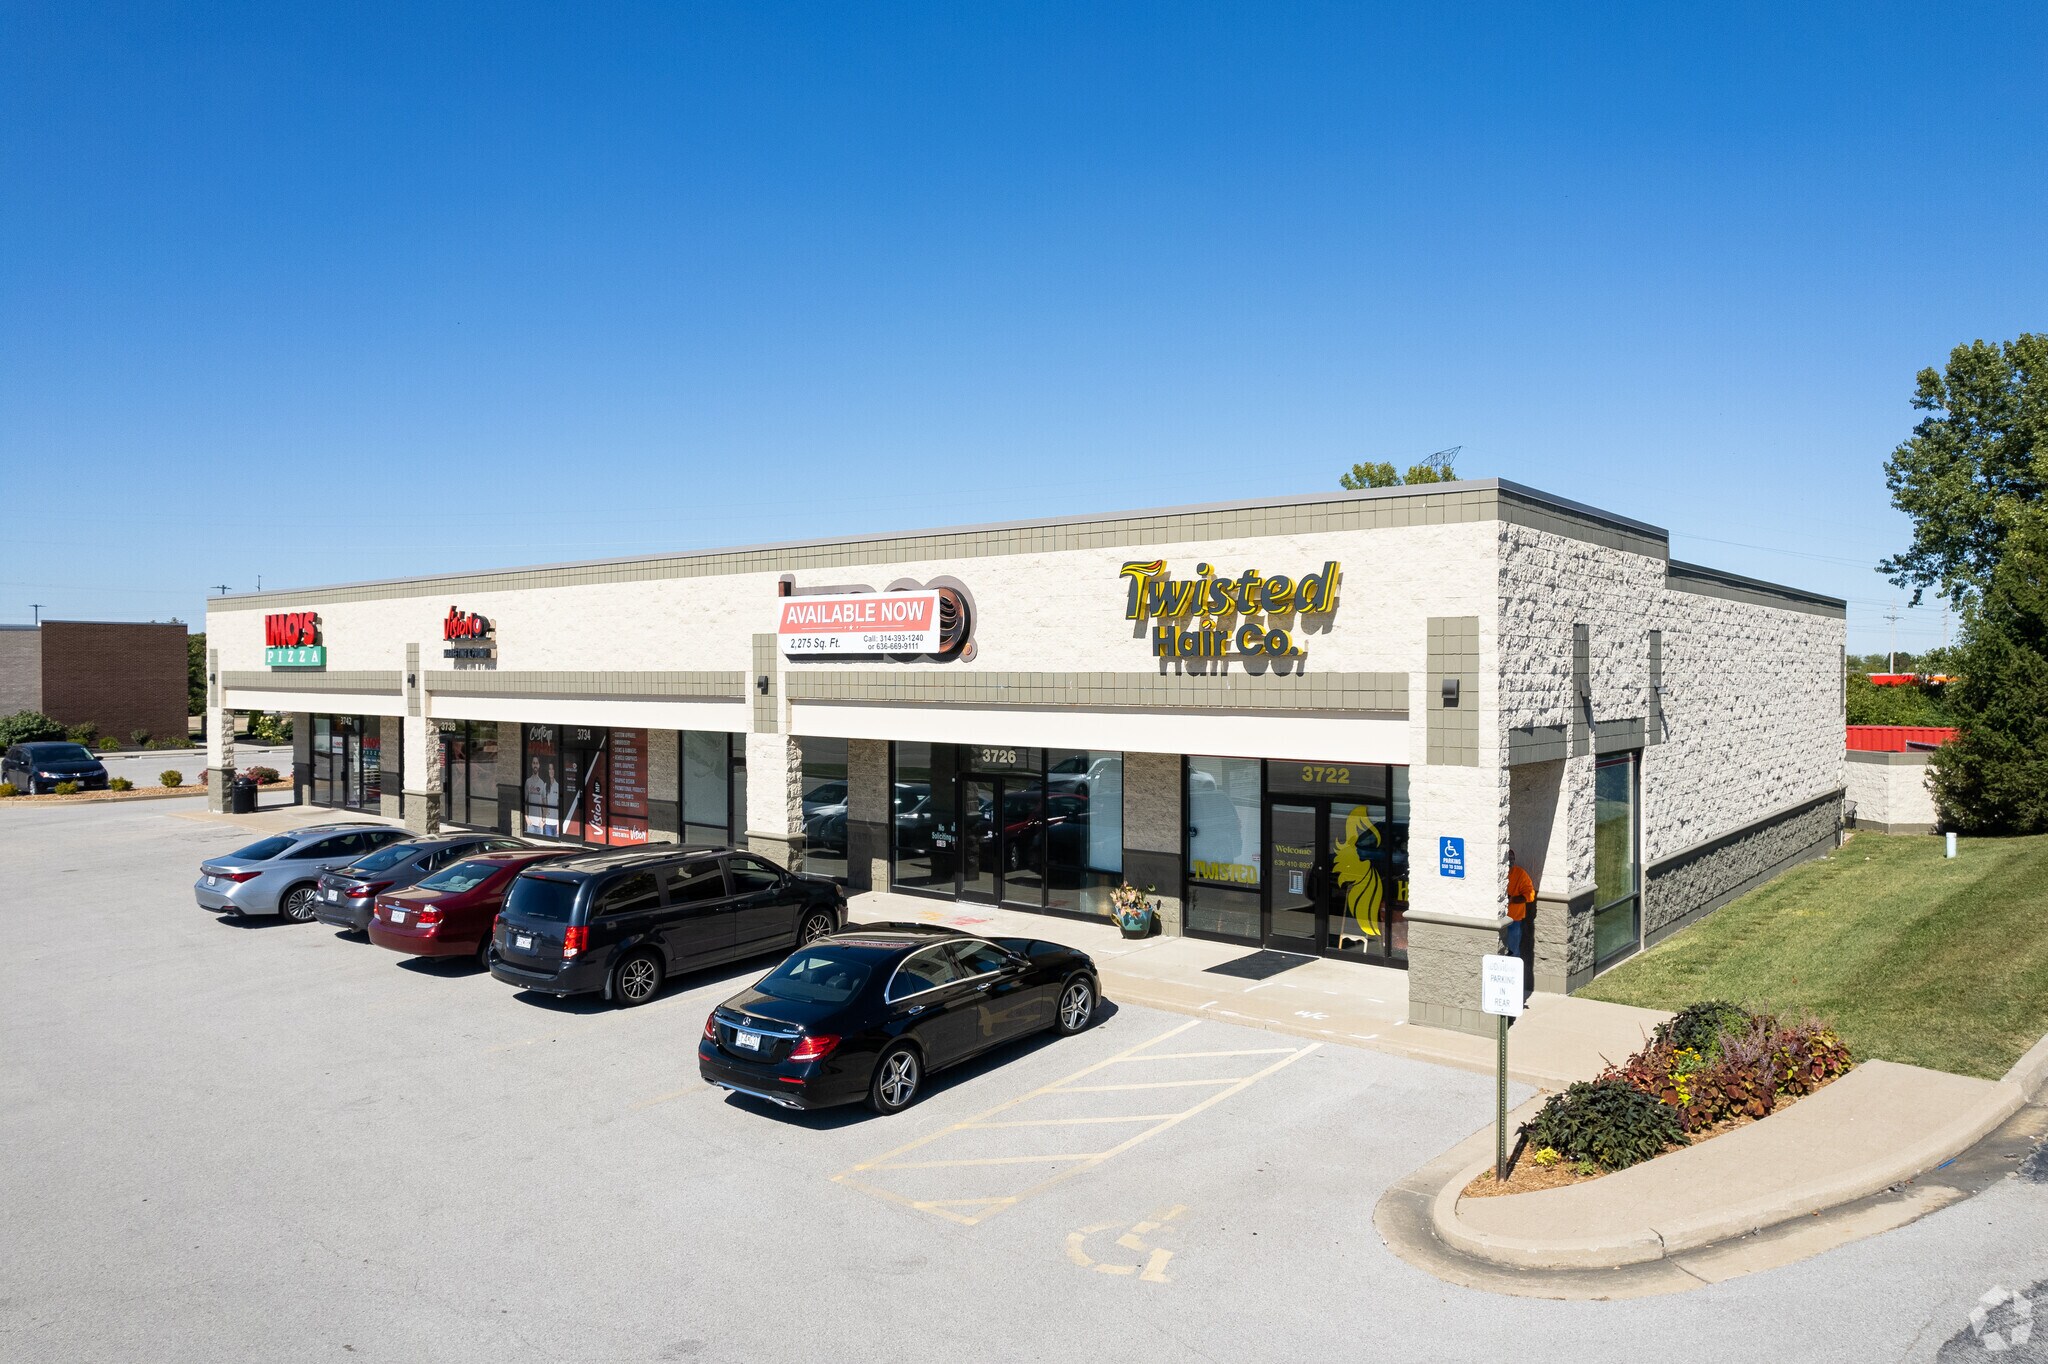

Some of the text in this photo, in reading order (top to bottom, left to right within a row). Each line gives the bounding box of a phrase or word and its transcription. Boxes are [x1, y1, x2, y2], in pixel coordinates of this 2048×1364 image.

[1119, 560, 1341, 620] Twisted
[786, 601, 925, 624] AVAILABLE NOW
[265, 611, 319, 648] IMO'S
[790, 637, 841, 650] 2,275 Sq. Ft.
[863, 634, 924, 643] Call: 314-393-1240
[1152, 619, 1303, 657] Hair Co.
[876, 642, 919, 650] 636-669-9111
[267, 649, 319, 663] PIZZA
[340, 716, 352, 726] 3742
[440, 721, 456, 732] 3738
[577, 728, 591, 741] 3734
[982, 749, 1017, 764] 3726
[1302, 765, 1350, 784] 3722
[595, 782, 601, 793] MP
[938, 823, 945, 832] No
[1275, 844, 1313, 856] Welcome
[1442, 857, 1462, 865] PARKING
[1192, 860, 1258, 885] TWISTED
[1490, 974, 1516, 986] PARKING
[1499, 987, 1506, 996] IN
[1494, 997, 1511, 1008] REAR
